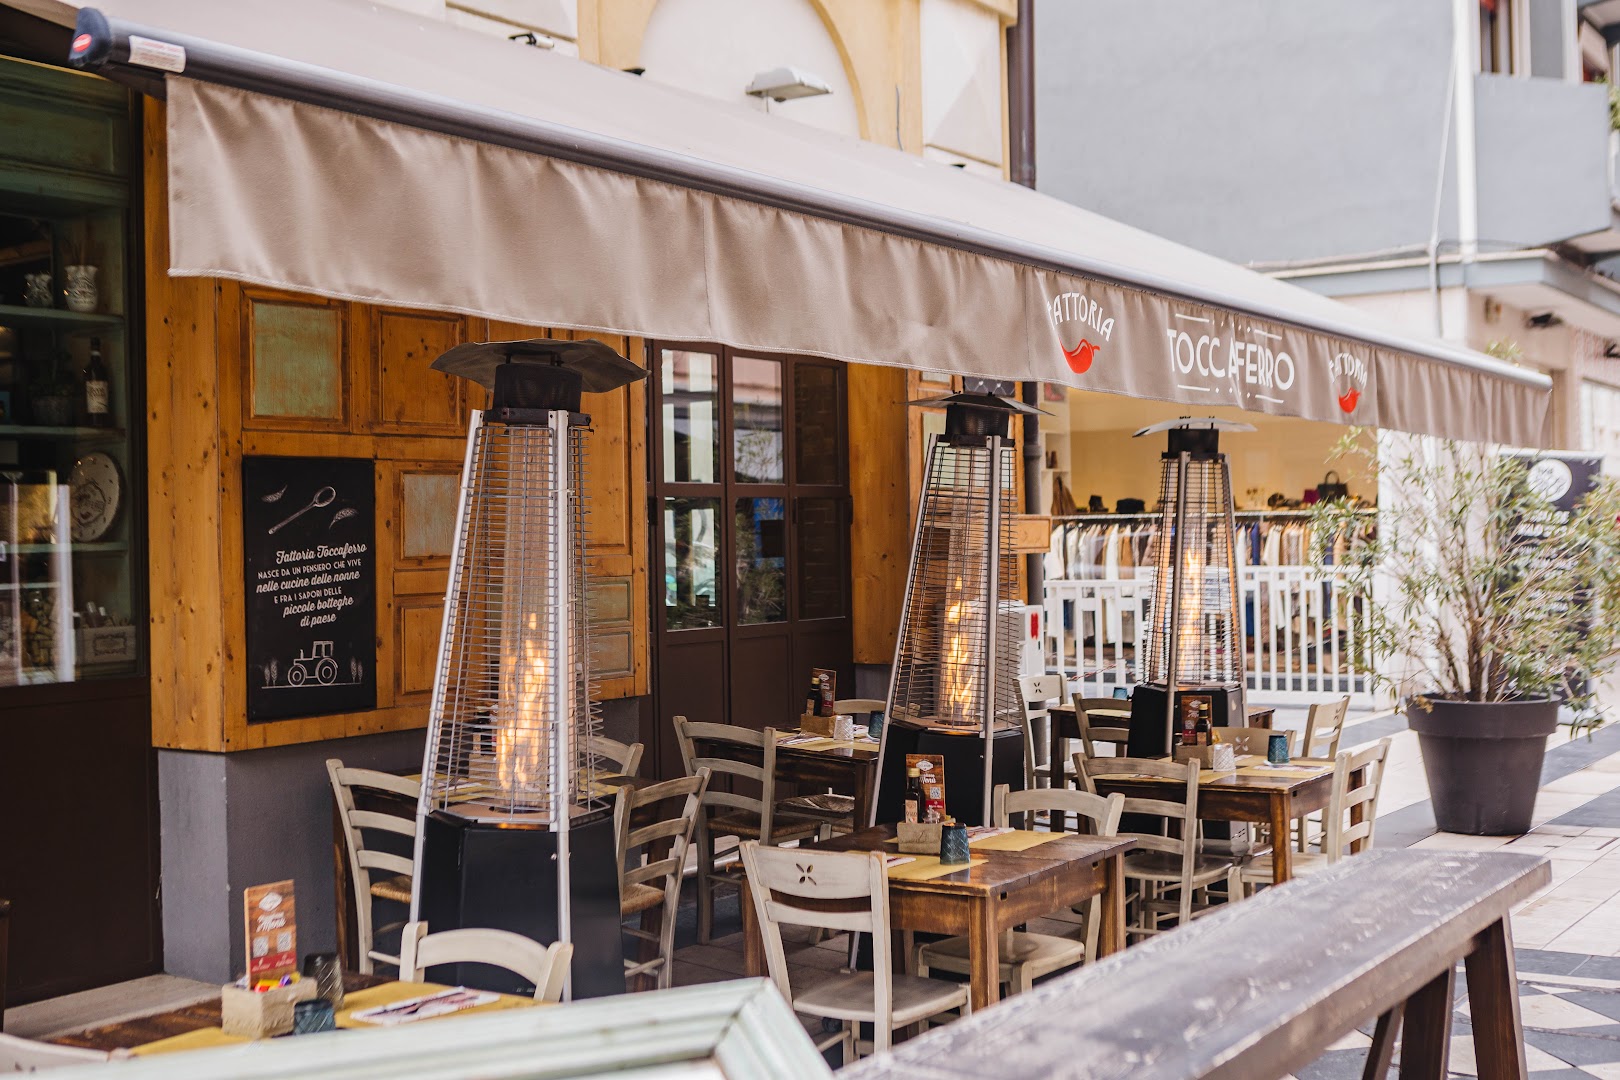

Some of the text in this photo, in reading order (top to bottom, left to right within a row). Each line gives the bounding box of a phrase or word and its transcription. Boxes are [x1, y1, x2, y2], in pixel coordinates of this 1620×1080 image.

[1166, 328, 1295, 391] TOCCAFERRO
[275, 542, 367, 565] Fattoria Toccaferro
[257, 558, 361, 580] NASCE DA UN PENSIERO CHE VIVE
[256, 570, 361, 594] nelle cucine delle nonne
[273, 596, 279, 604] E
[280, 594, 293, 603] FRA
[298, 589, 323, 601] SAPORI
[323, 586, 342, 597] DELLE
[282, 595, 354, 618] piccole botteghe
[300, 613, 337, 628] di paese
